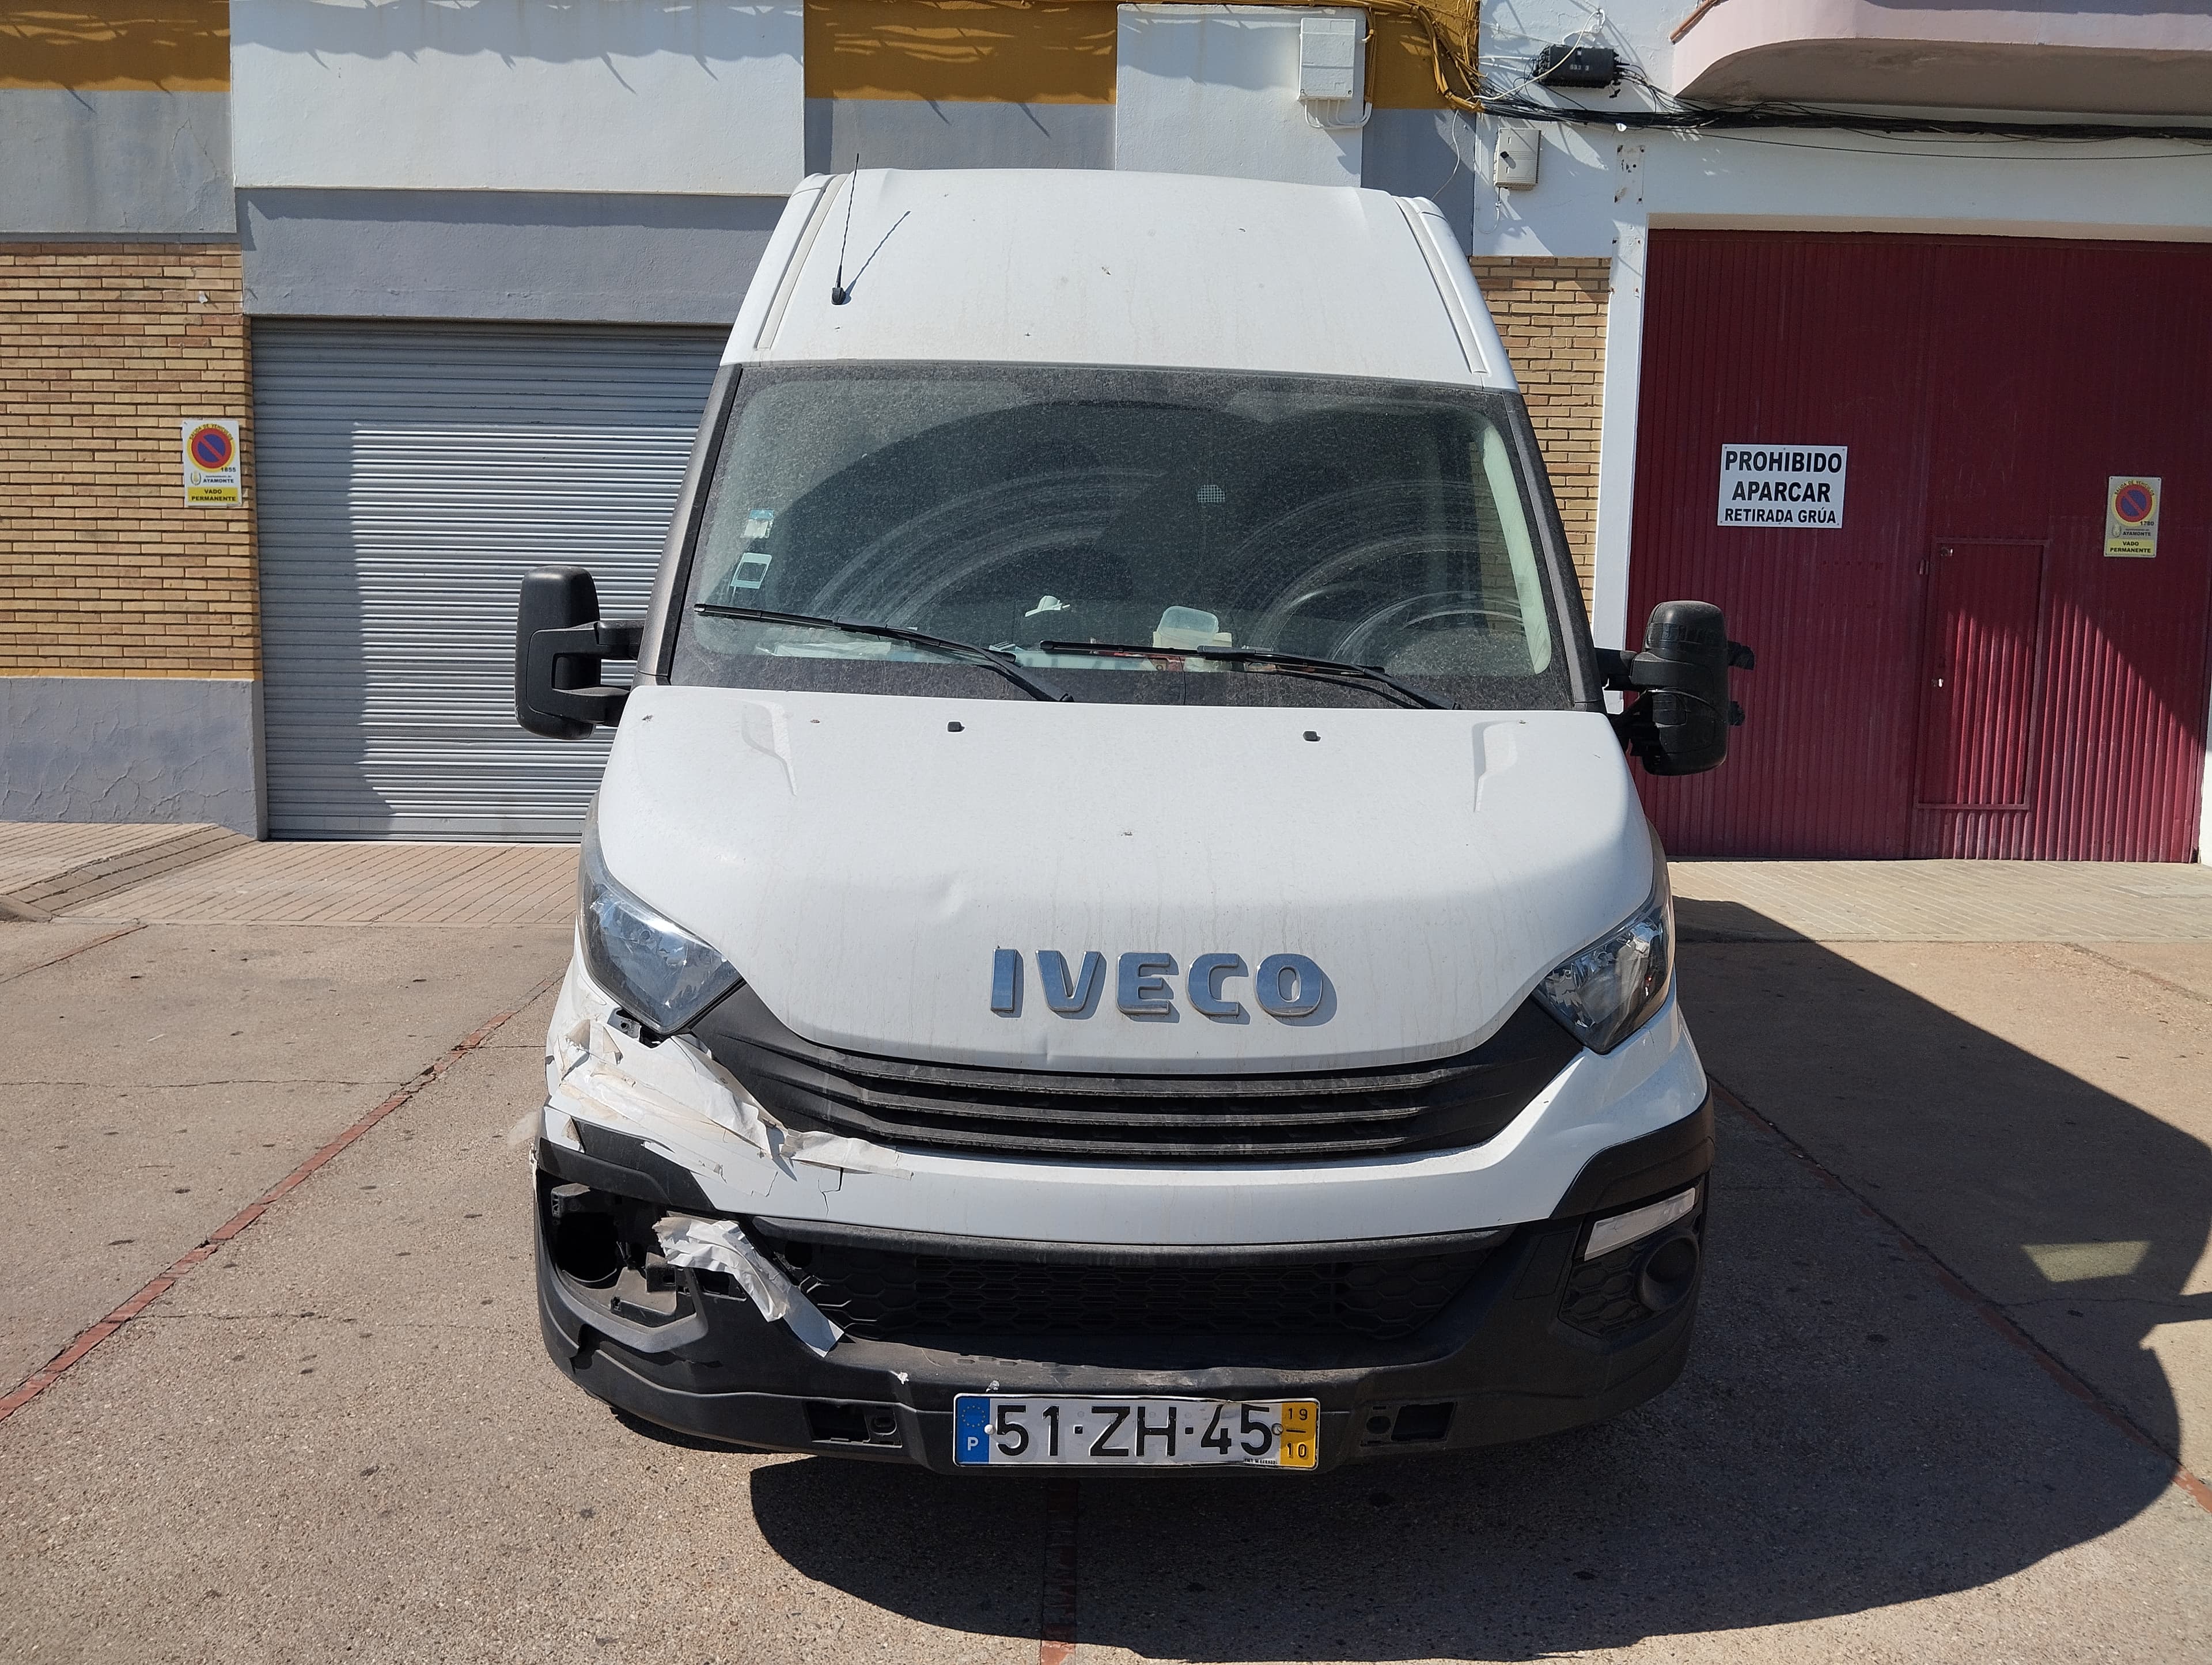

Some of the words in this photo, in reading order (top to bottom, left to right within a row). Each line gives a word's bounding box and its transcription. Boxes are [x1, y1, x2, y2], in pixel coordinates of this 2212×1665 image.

[1725, 450, 1842, 473] PROHIBIDO
[1731, 481, 1831, 502] APARCAR
[1724, 508, 1793, 522] RETIRADA
[1798, 507, 1836, 524] GRÚA
[991, 949, 1324, 1017] IVECO
[1287, 1408, 1308, 1421] 19
[967, 1437, 979, 1451] P
[1286, 1442, 1308, 1458] 10
